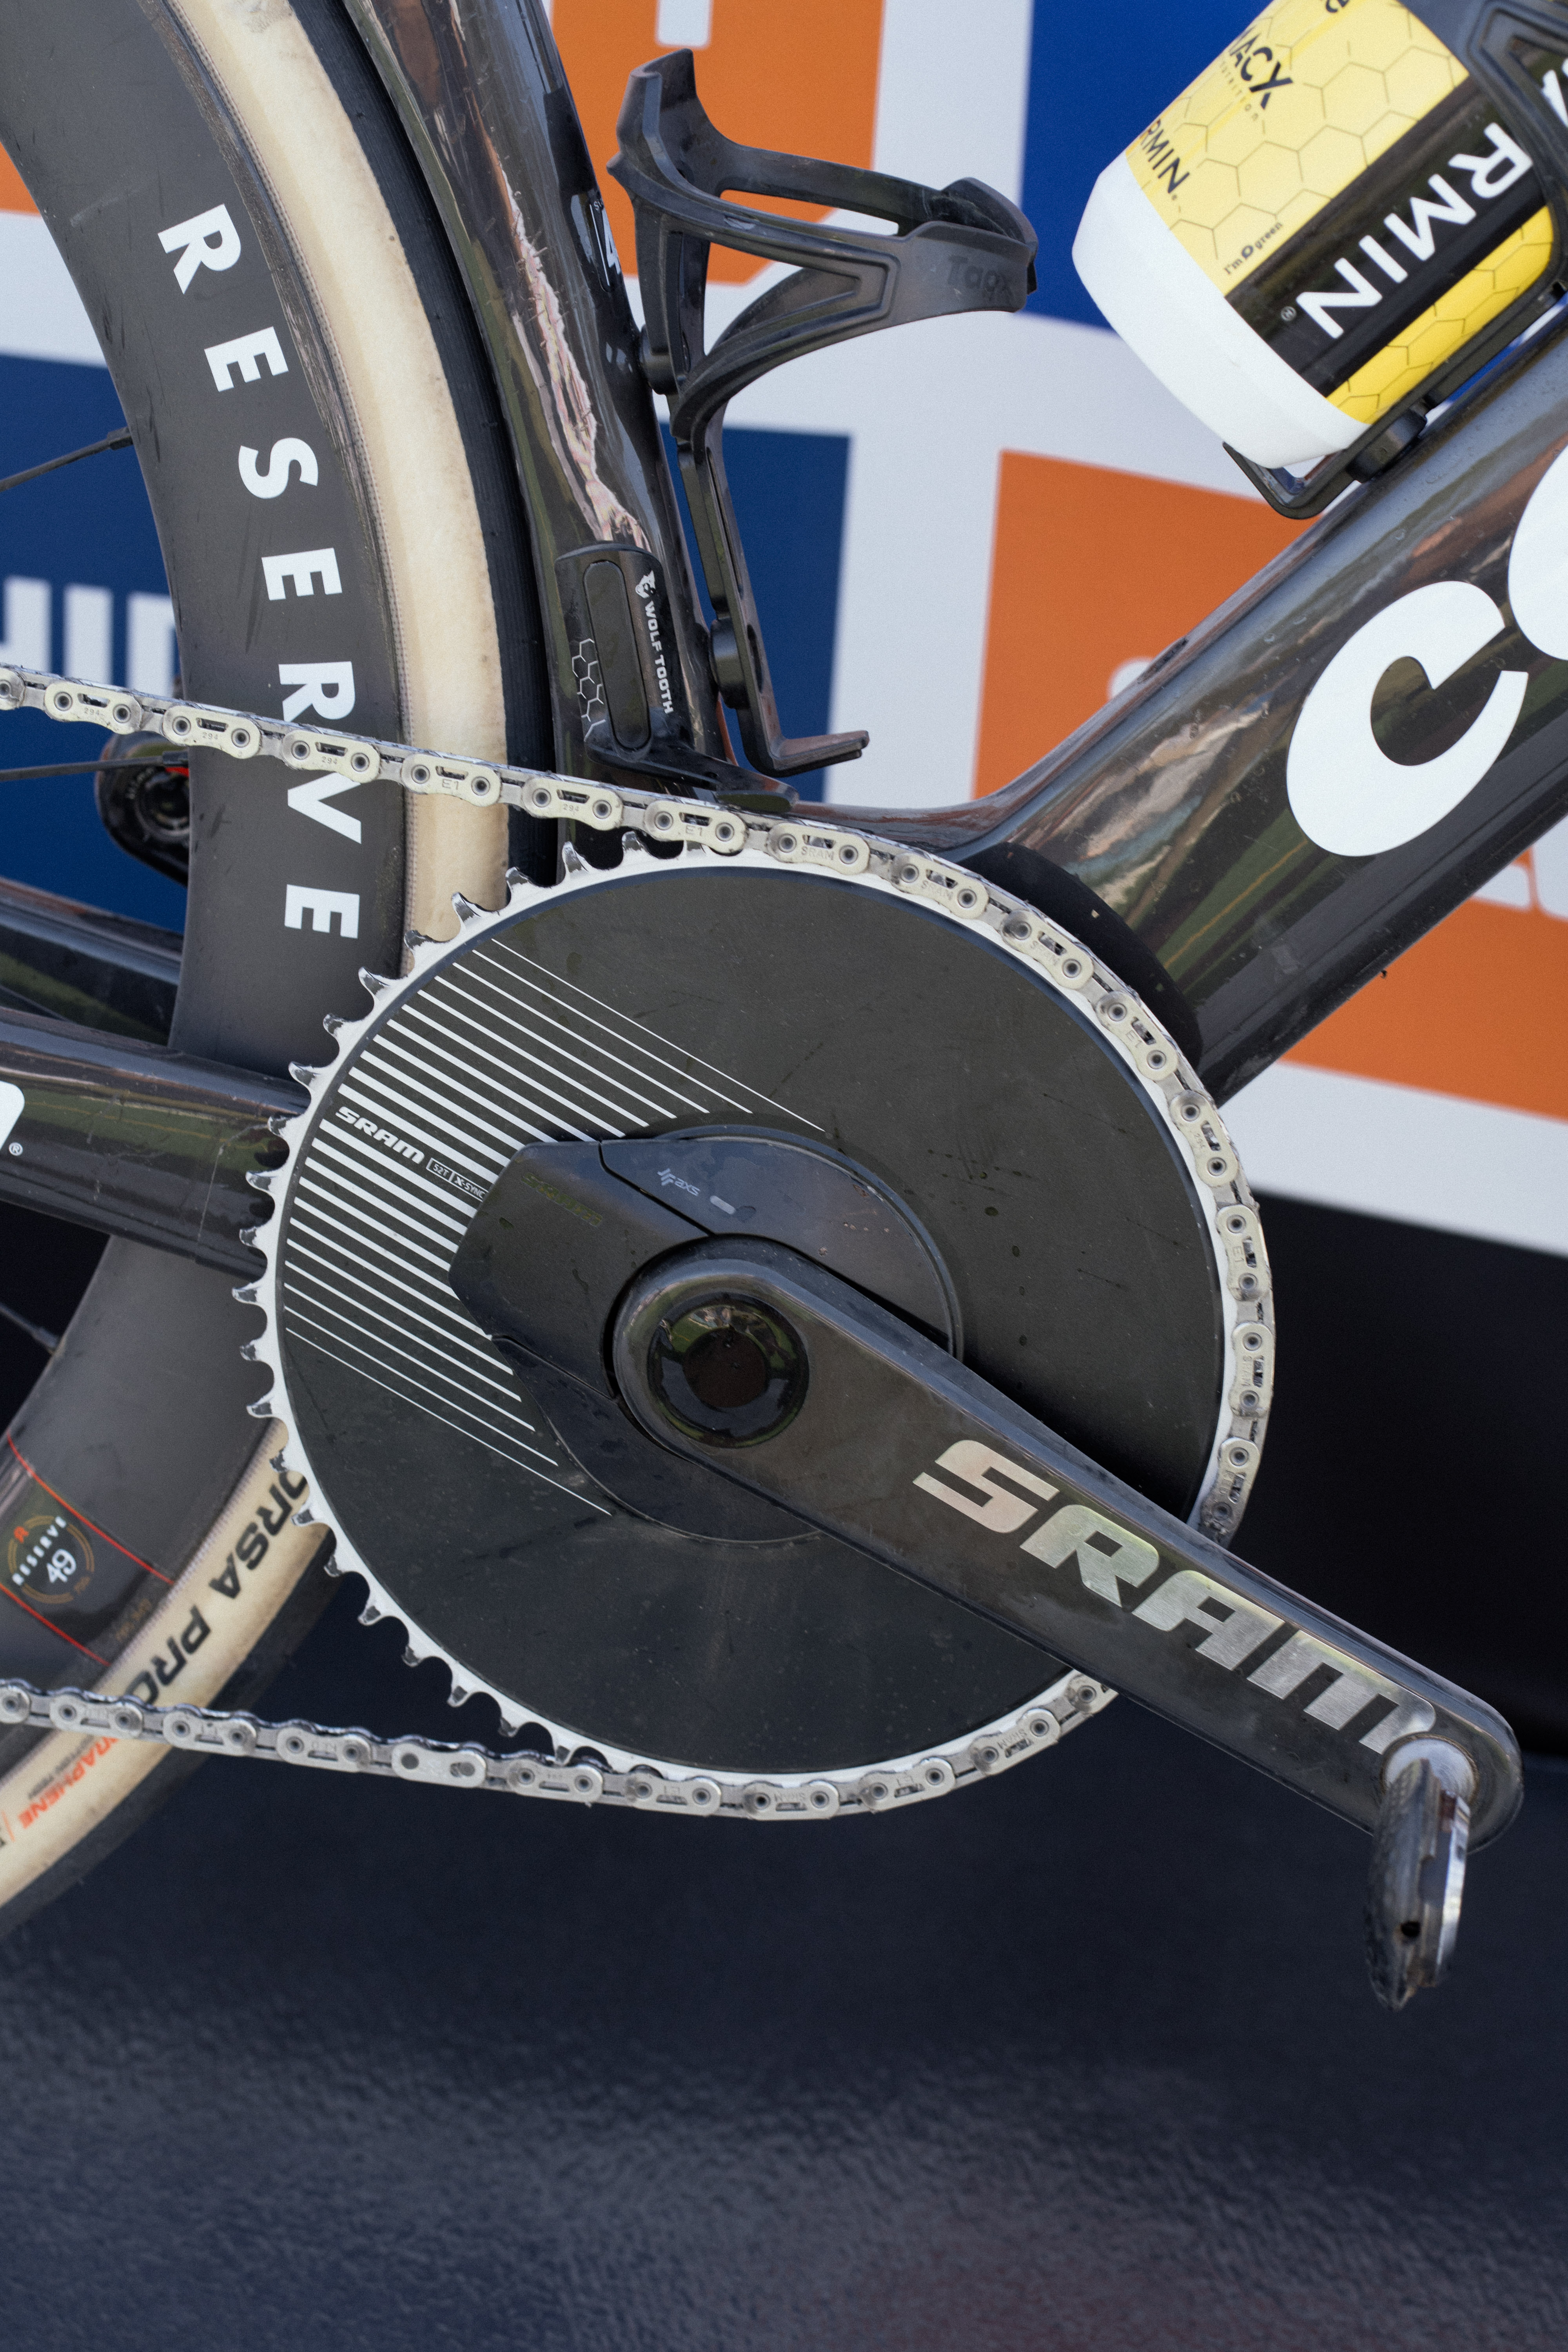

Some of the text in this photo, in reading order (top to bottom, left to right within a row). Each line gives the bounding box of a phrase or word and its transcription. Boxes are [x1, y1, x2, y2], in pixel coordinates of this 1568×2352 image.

[1255, 221, 1283, 250] green
[157, 203, 361, 939] RESERVE
[644, 601, 673, 714] WOLF TOOTH
[321, 756, 338, 765] 294
[442, 779, 459, 790] E1
[563, 803, 579, 812] 294
[685, 826, 703, 836] E1
[801, 846, 834, 860] SRAM
[335, 1106, 425, 1164] SRAM
[433, 1163, 486, 1199] 52T X-SYNC
[46, 1548, 77, 1584] 49
[913, 1439, 1436, 1756] SRAM
[18, 1736, 119, 1830] RAPHENE
